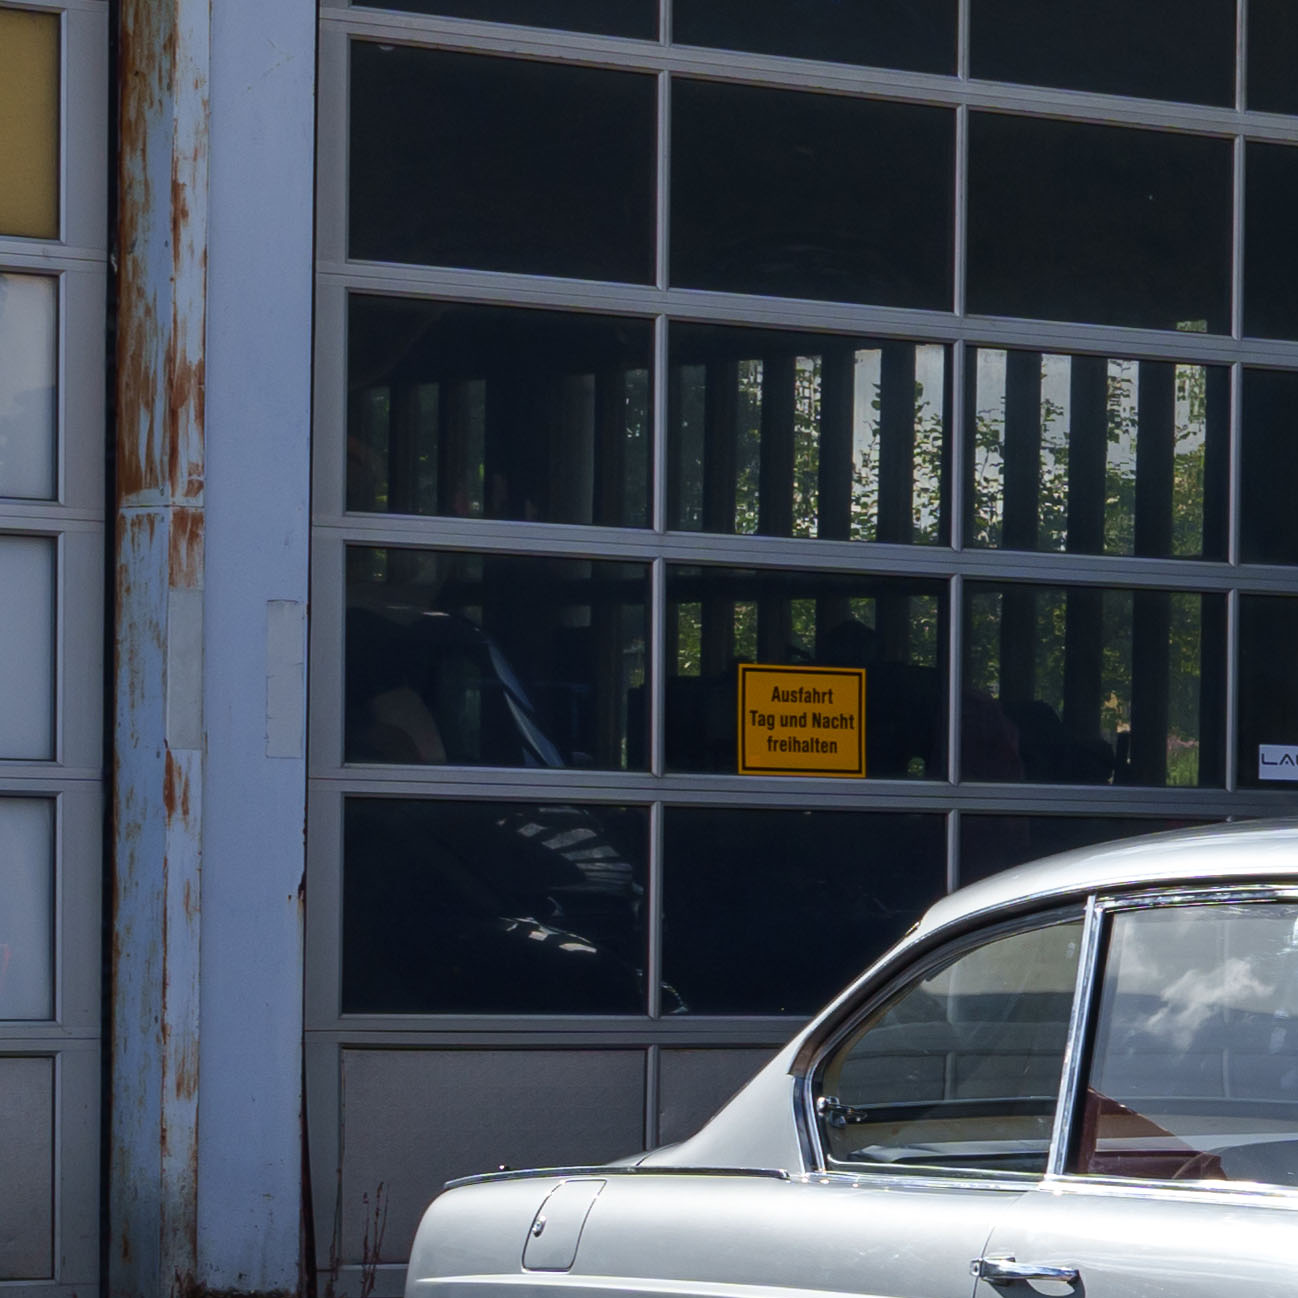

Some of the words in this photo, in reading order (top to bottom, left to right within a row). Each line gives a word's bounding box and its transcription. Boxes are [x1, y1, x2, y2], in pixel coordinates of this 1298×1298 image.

[771, 686, 833, 704] Ausfahrt
[749, 710, 775, 731] Tag
[780, 712, 807, 728] und
[812, 712, 855, 730] Nacht
[767, 735, 837, 754] freihalten
